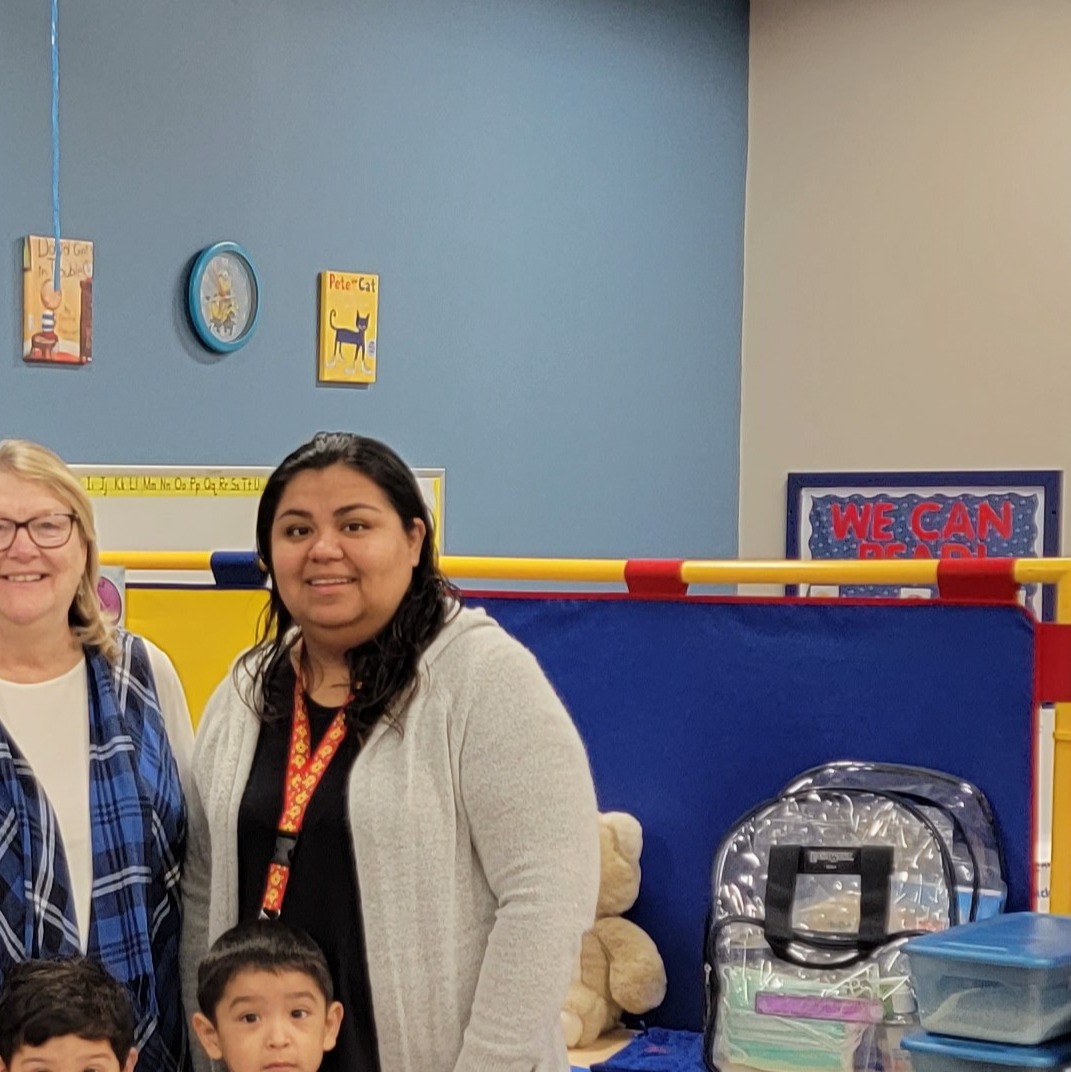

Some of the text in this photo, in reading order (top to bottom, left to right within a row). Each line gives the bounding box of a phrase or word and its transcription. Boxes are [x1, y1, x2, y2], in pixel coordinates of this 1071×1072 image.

[330, 273, 351, 291] Pete
[358, 277, 376, 293] Cat
[143, 477, 157, 491] Mm
[160, 477, 171, 491] Nn
[190, 477, 200, 496] Pp
[830, 500, 1014, 541] WE CAN
